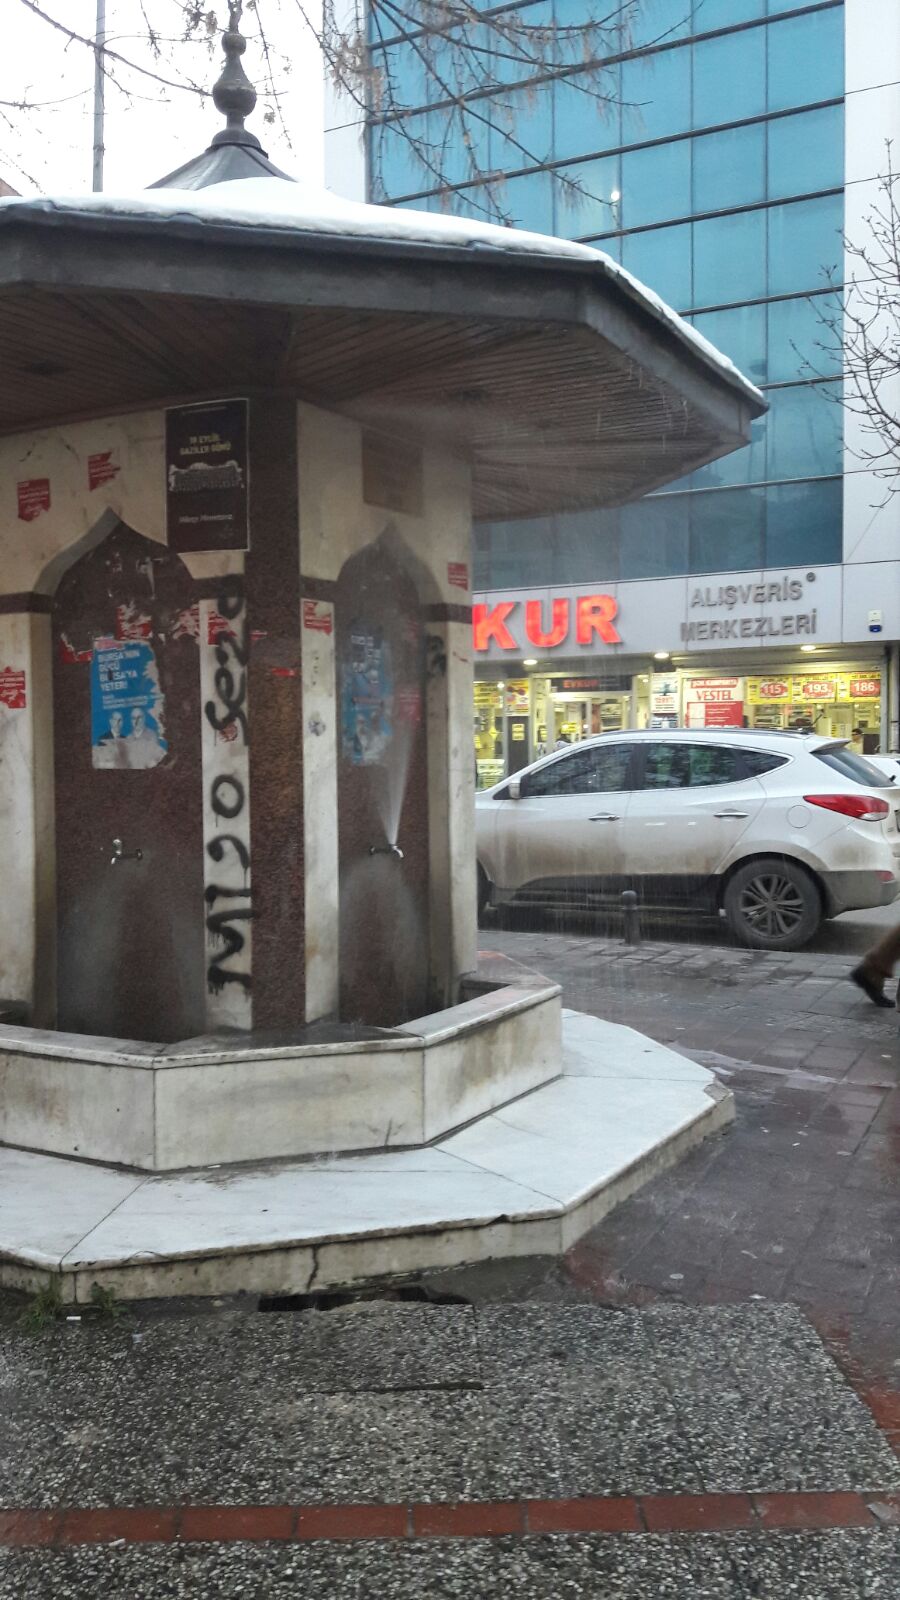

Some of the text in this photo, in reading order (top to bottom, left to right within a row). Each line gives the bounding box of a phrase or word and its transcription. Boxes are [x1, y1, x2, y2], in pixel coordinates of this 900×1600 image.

[472, 594, 621, 651] KUR
[680, 608, 817, 642] MERKEZLERİ
[696, 690, 733, 701] VESTEL
